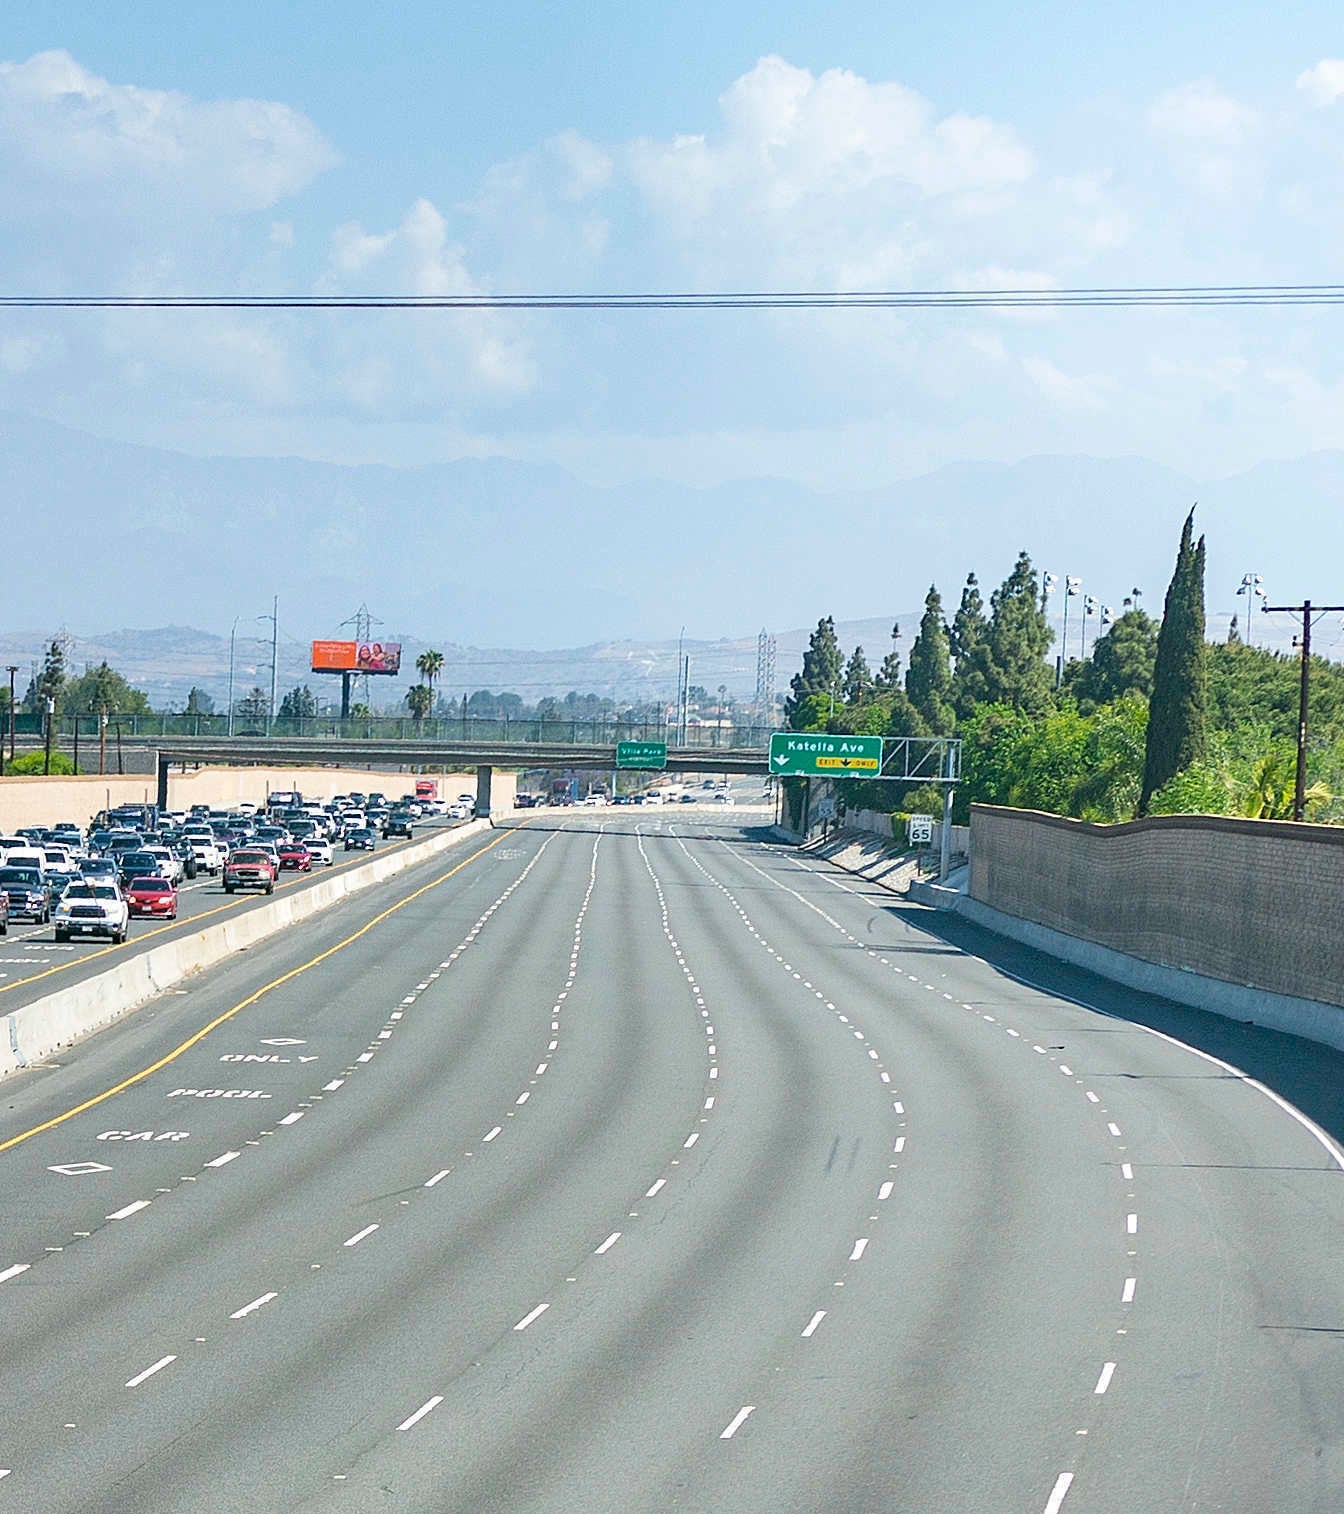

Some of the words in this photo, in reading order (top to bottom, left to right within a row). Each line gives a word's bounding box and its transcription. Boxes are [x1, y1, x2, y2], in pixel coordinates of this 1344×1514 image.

[787, 740, 834, 752] Katella
[840, 742, 865, 752] Ave
[912, 829, 930, 840] 65
[219, 1054, 319, 1063] ONLY
[167, 1088, 273, 1099] POOL
[96, 1130, 191, 1142] CAR
